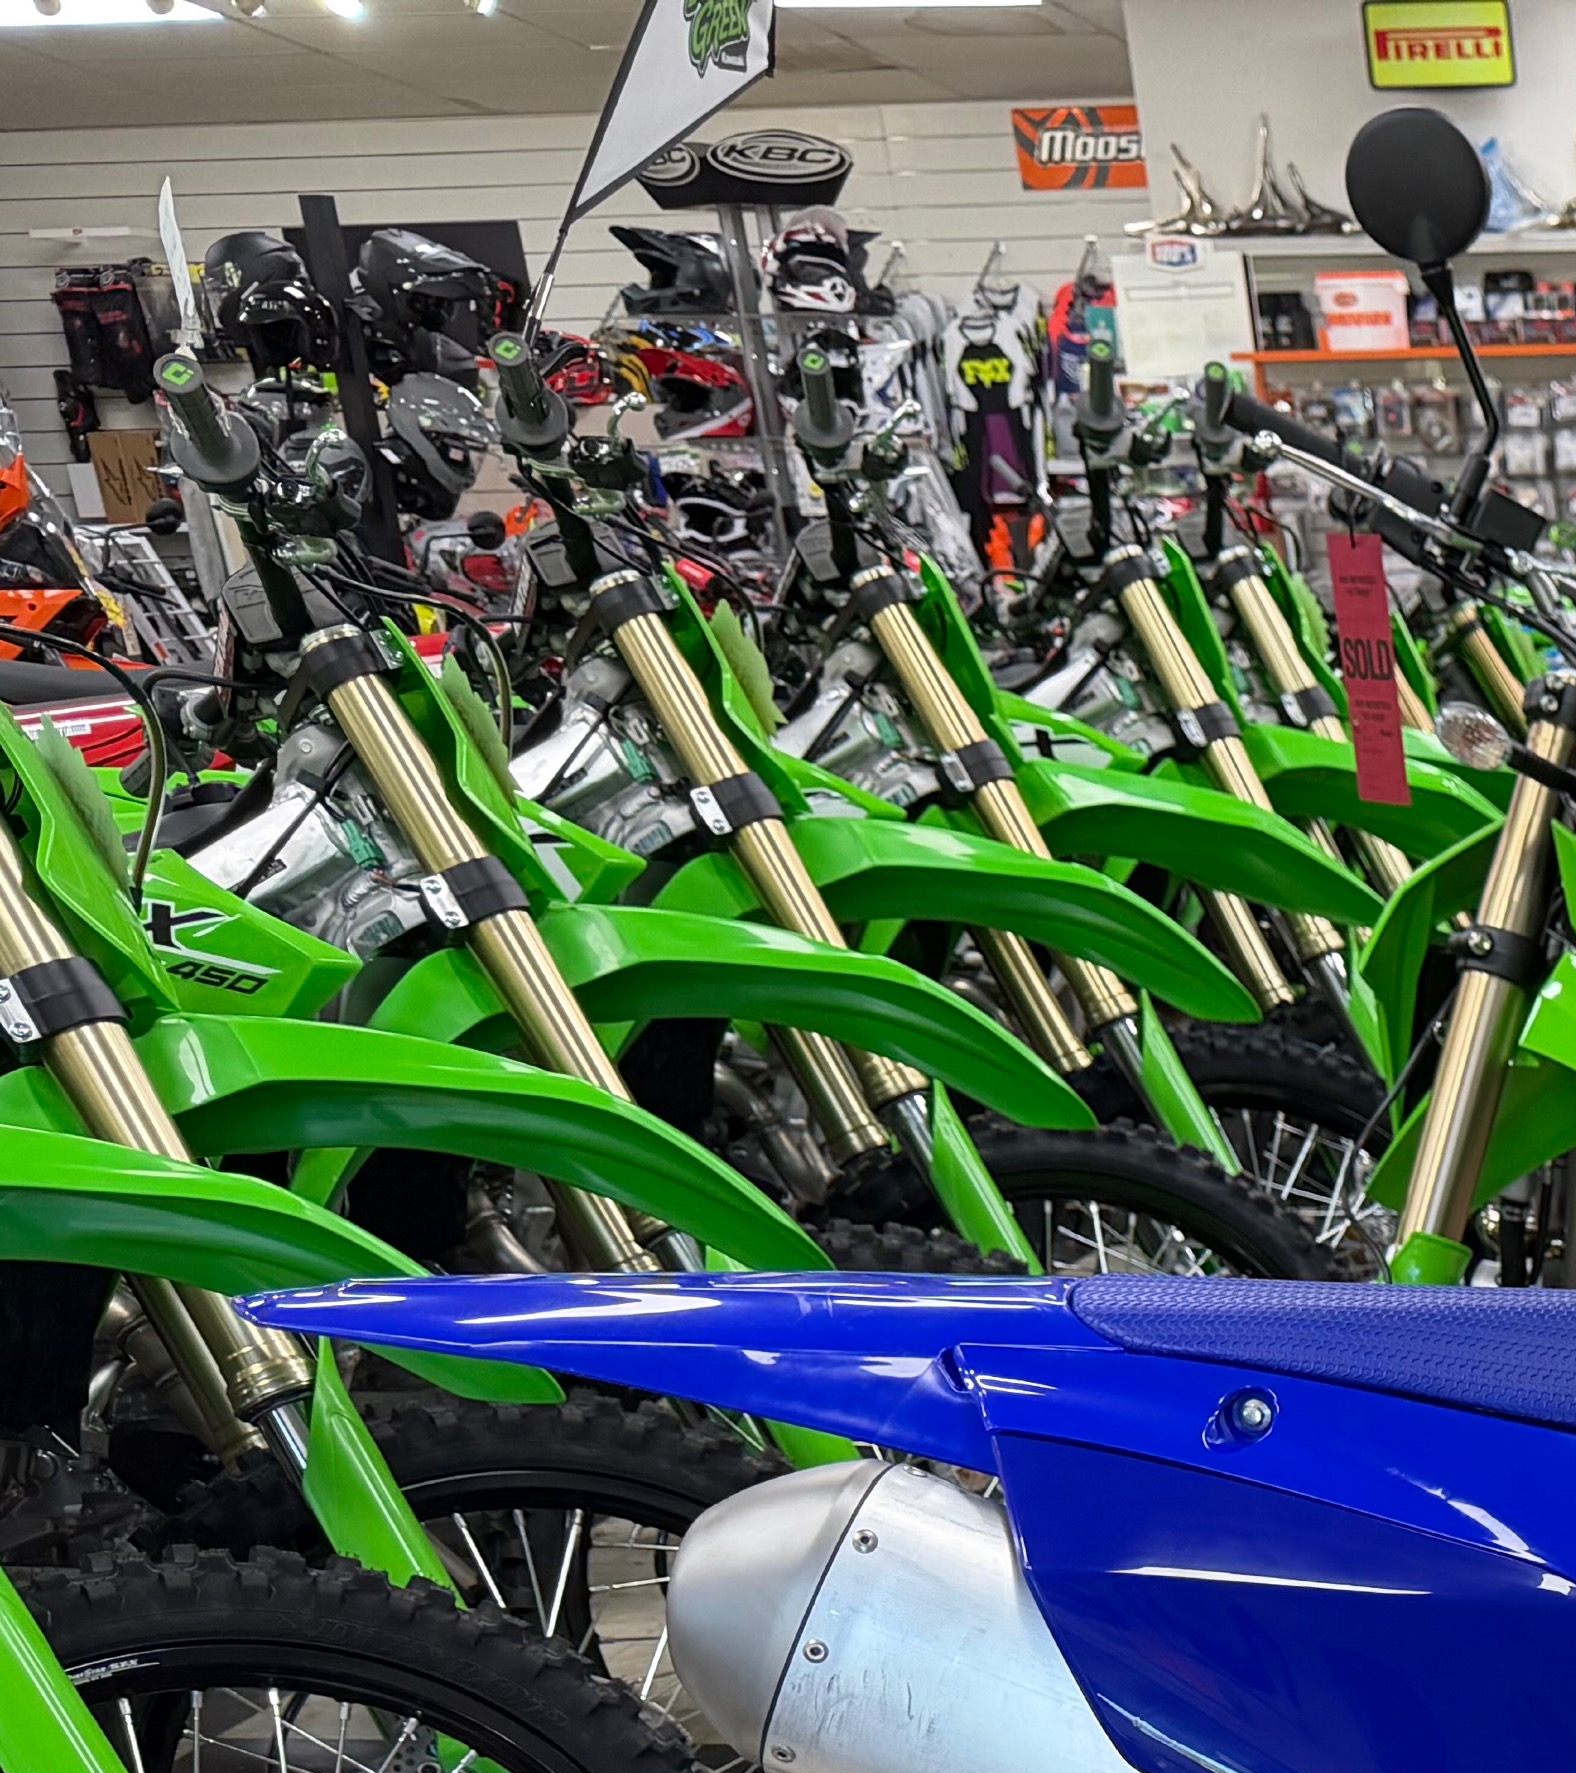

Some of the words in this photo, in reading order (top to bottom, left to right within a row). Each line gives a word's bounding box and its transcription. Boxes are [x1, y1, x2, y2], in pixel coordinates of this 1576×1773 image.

[1375, 26, 1502, 61] PIRELLI
[722, 143, 838, 164] KBC
[1038, 129, 1145, 165] MOOS
[960, 357, 1012, 390] FOX
[1343, 637, 1394, 682] SOLD
[165, 959, 269, 995] 450
